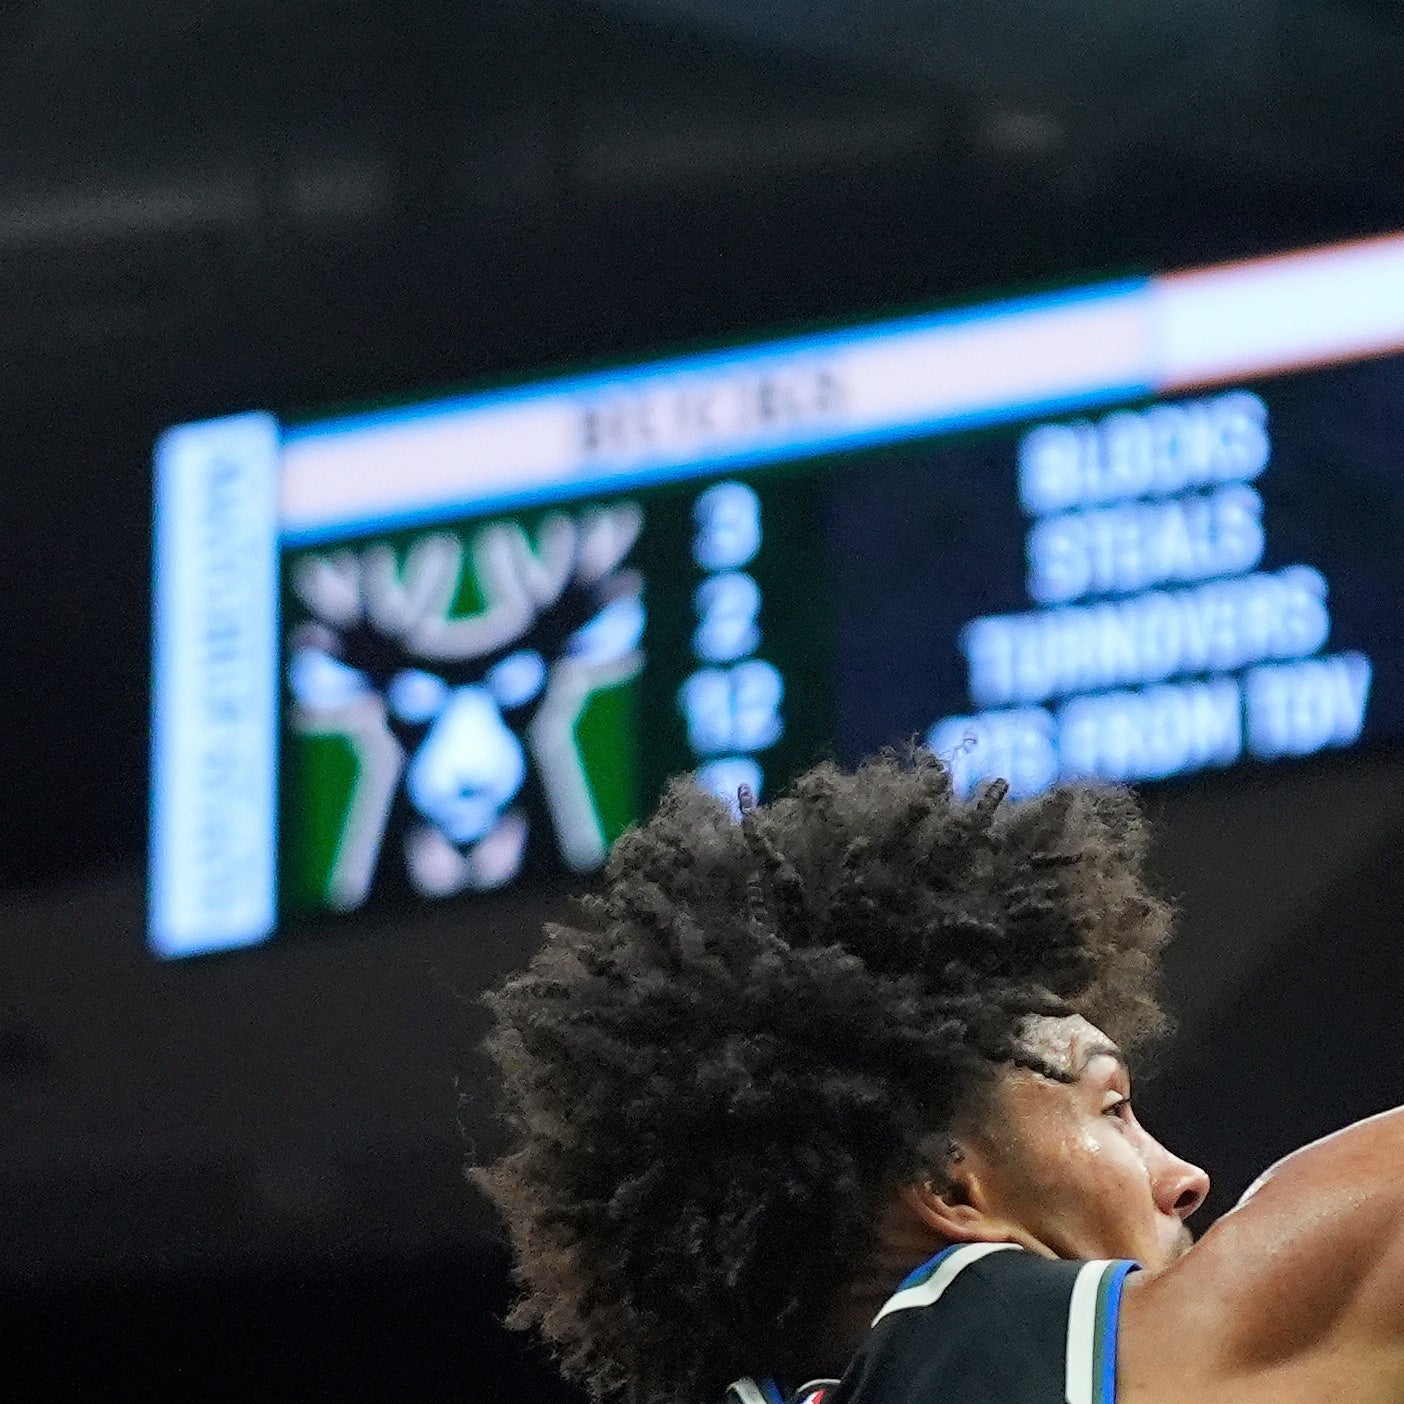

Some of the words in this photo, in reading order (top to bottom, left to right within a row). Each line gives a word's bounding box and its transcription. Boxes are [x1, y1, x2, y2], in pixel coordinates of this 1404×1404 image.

[1018, 390, 1270, 518] BLOCKS
[1027, 482, 1266, 604] STEALS
[962, 566, 1330, 706] TURNOVERS
[1056, 678, 1242, 782] FROM
